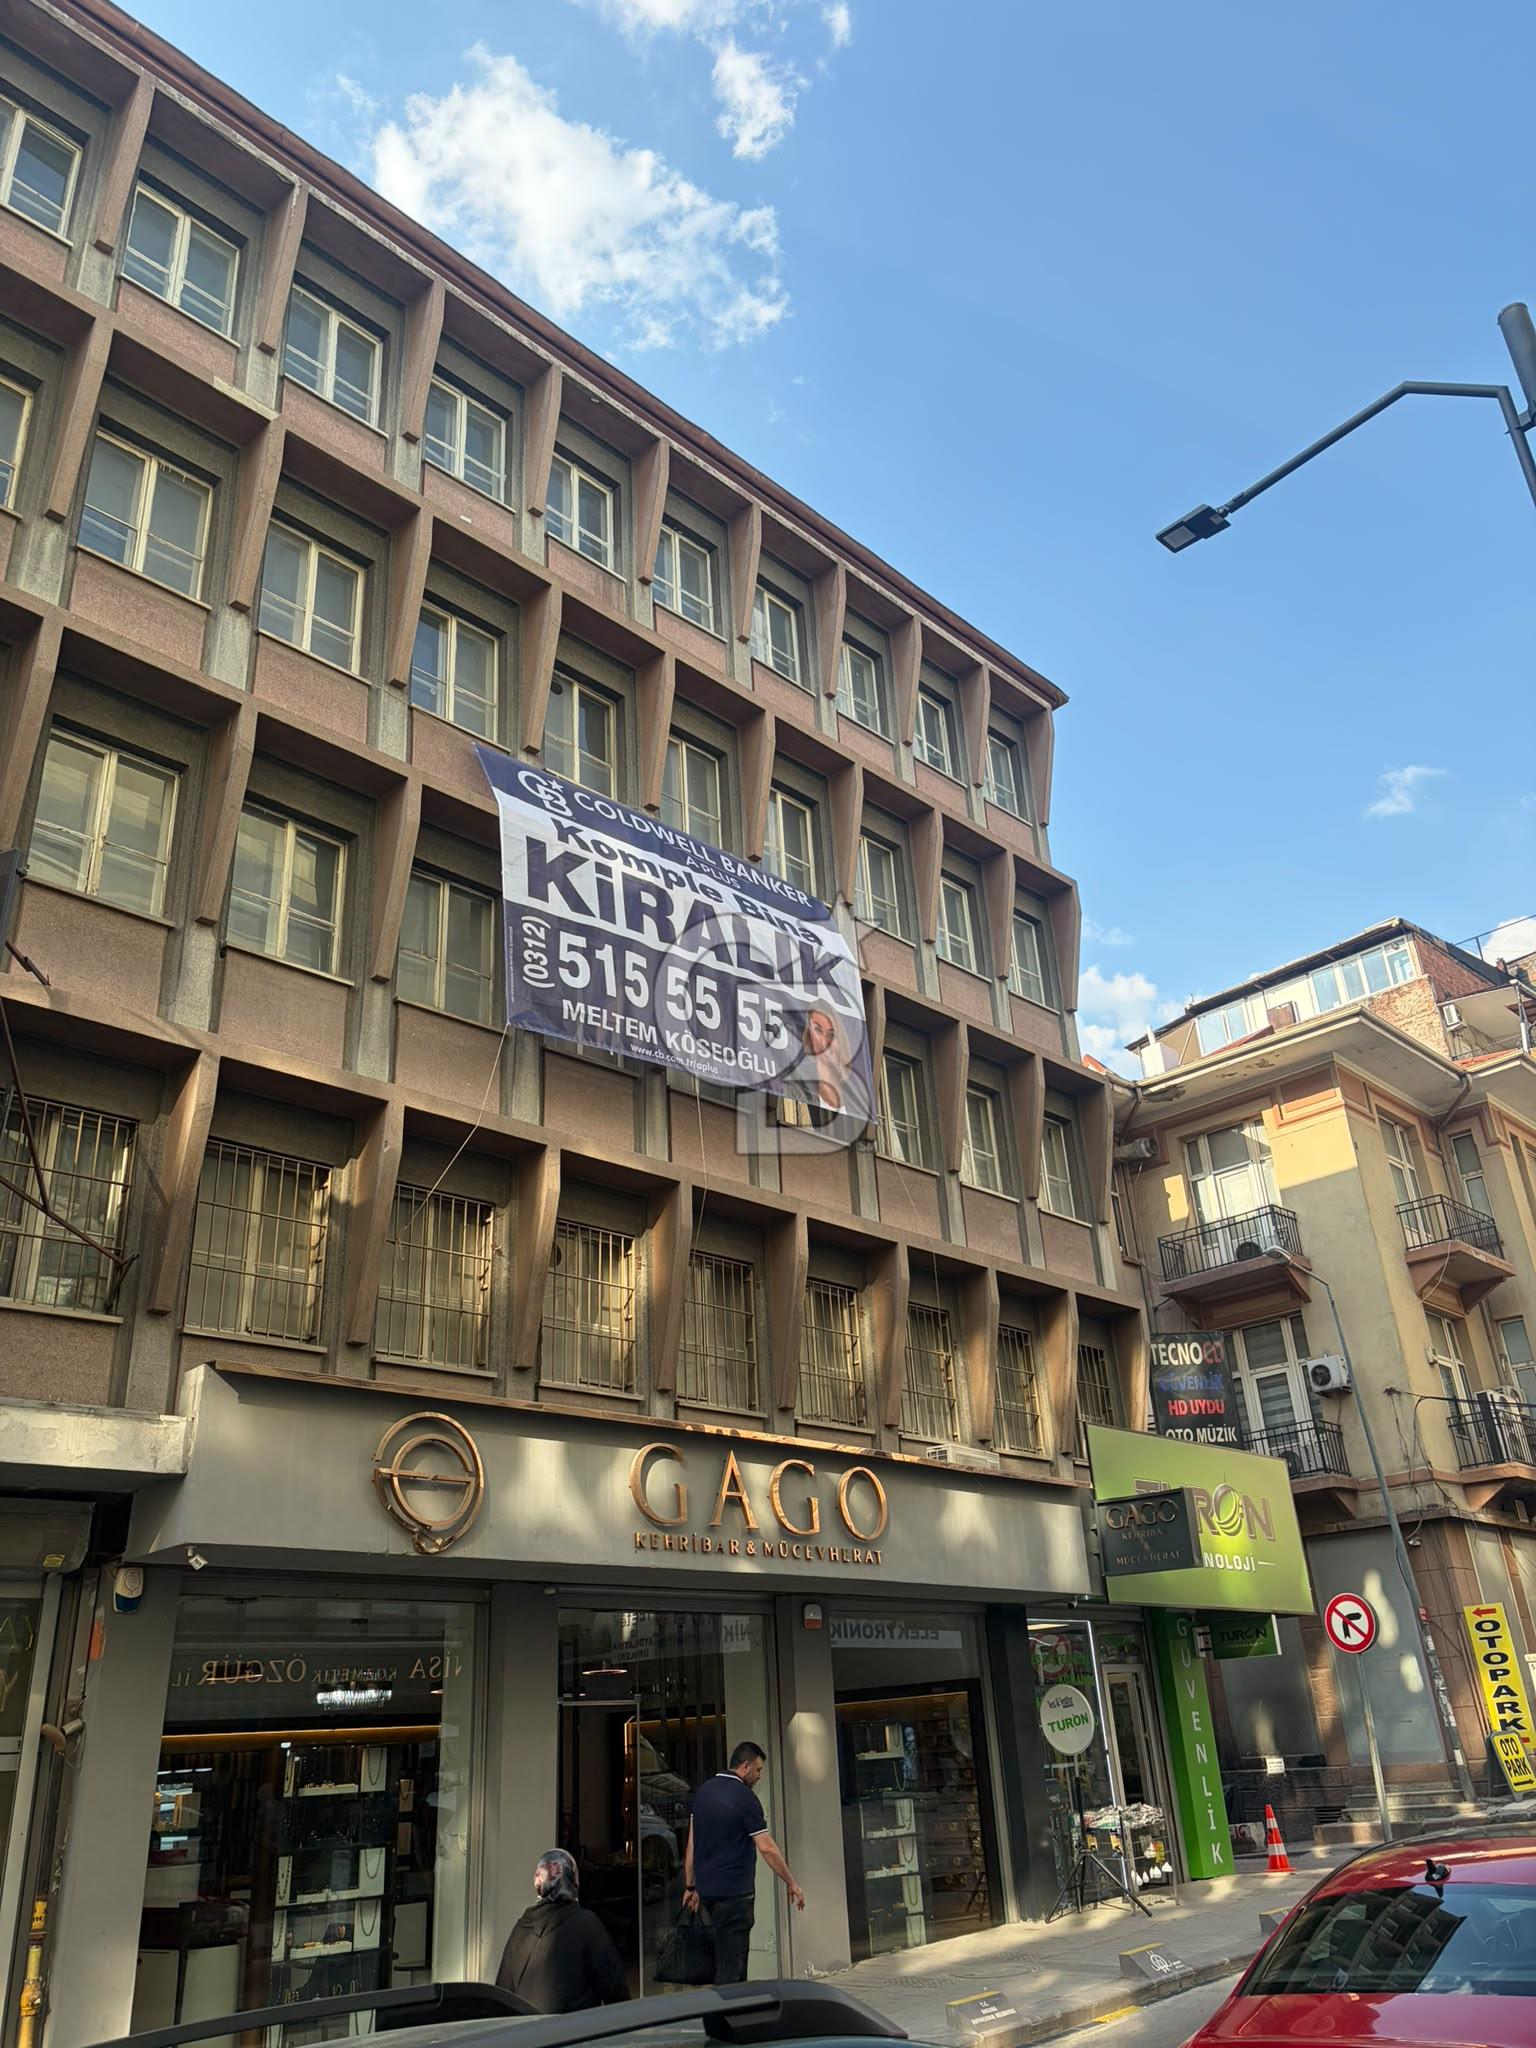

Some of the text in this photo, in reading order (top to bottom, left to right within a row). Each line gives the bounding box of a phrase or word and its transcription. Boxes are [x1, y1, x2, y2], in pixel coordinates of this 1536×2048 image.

[573, 791, 716, 865] COLDWELL
[719, 854, 813, 908] BANKER
[551, 817, 824, 947] Komple Bina
[702, 863, 741, 889] PLUS
[521, 915, 556, 989] (0312)
[558, 930, 650, 1009] 515
[666, 965, 721, 1030] 55
[737, 988, 789, 1050] 55
[562, 999, 777, 1078] MELTEM KÖSEOĞLU
[630, 1043, 719, 1075] www.cb.com.tr/aplus
[1168, 1399, 1225, 1416] HD UYDU
[1166, 1423, 1238, 1443] OTO MÜZİK
[629, 1442, 888, 1542] GAGO
[1105, 1499, 1180, 1530] GAGO
[634, 1531, 739, 1554] KEHRİBAR
[1474, 1619, 1528, 1732] OTOPARK
[1048, 1713, 1090, 1733] TURON
[1499, 1738, 1520, 1756] OTO
[1504, 1758, 1532, 1778] PARK
